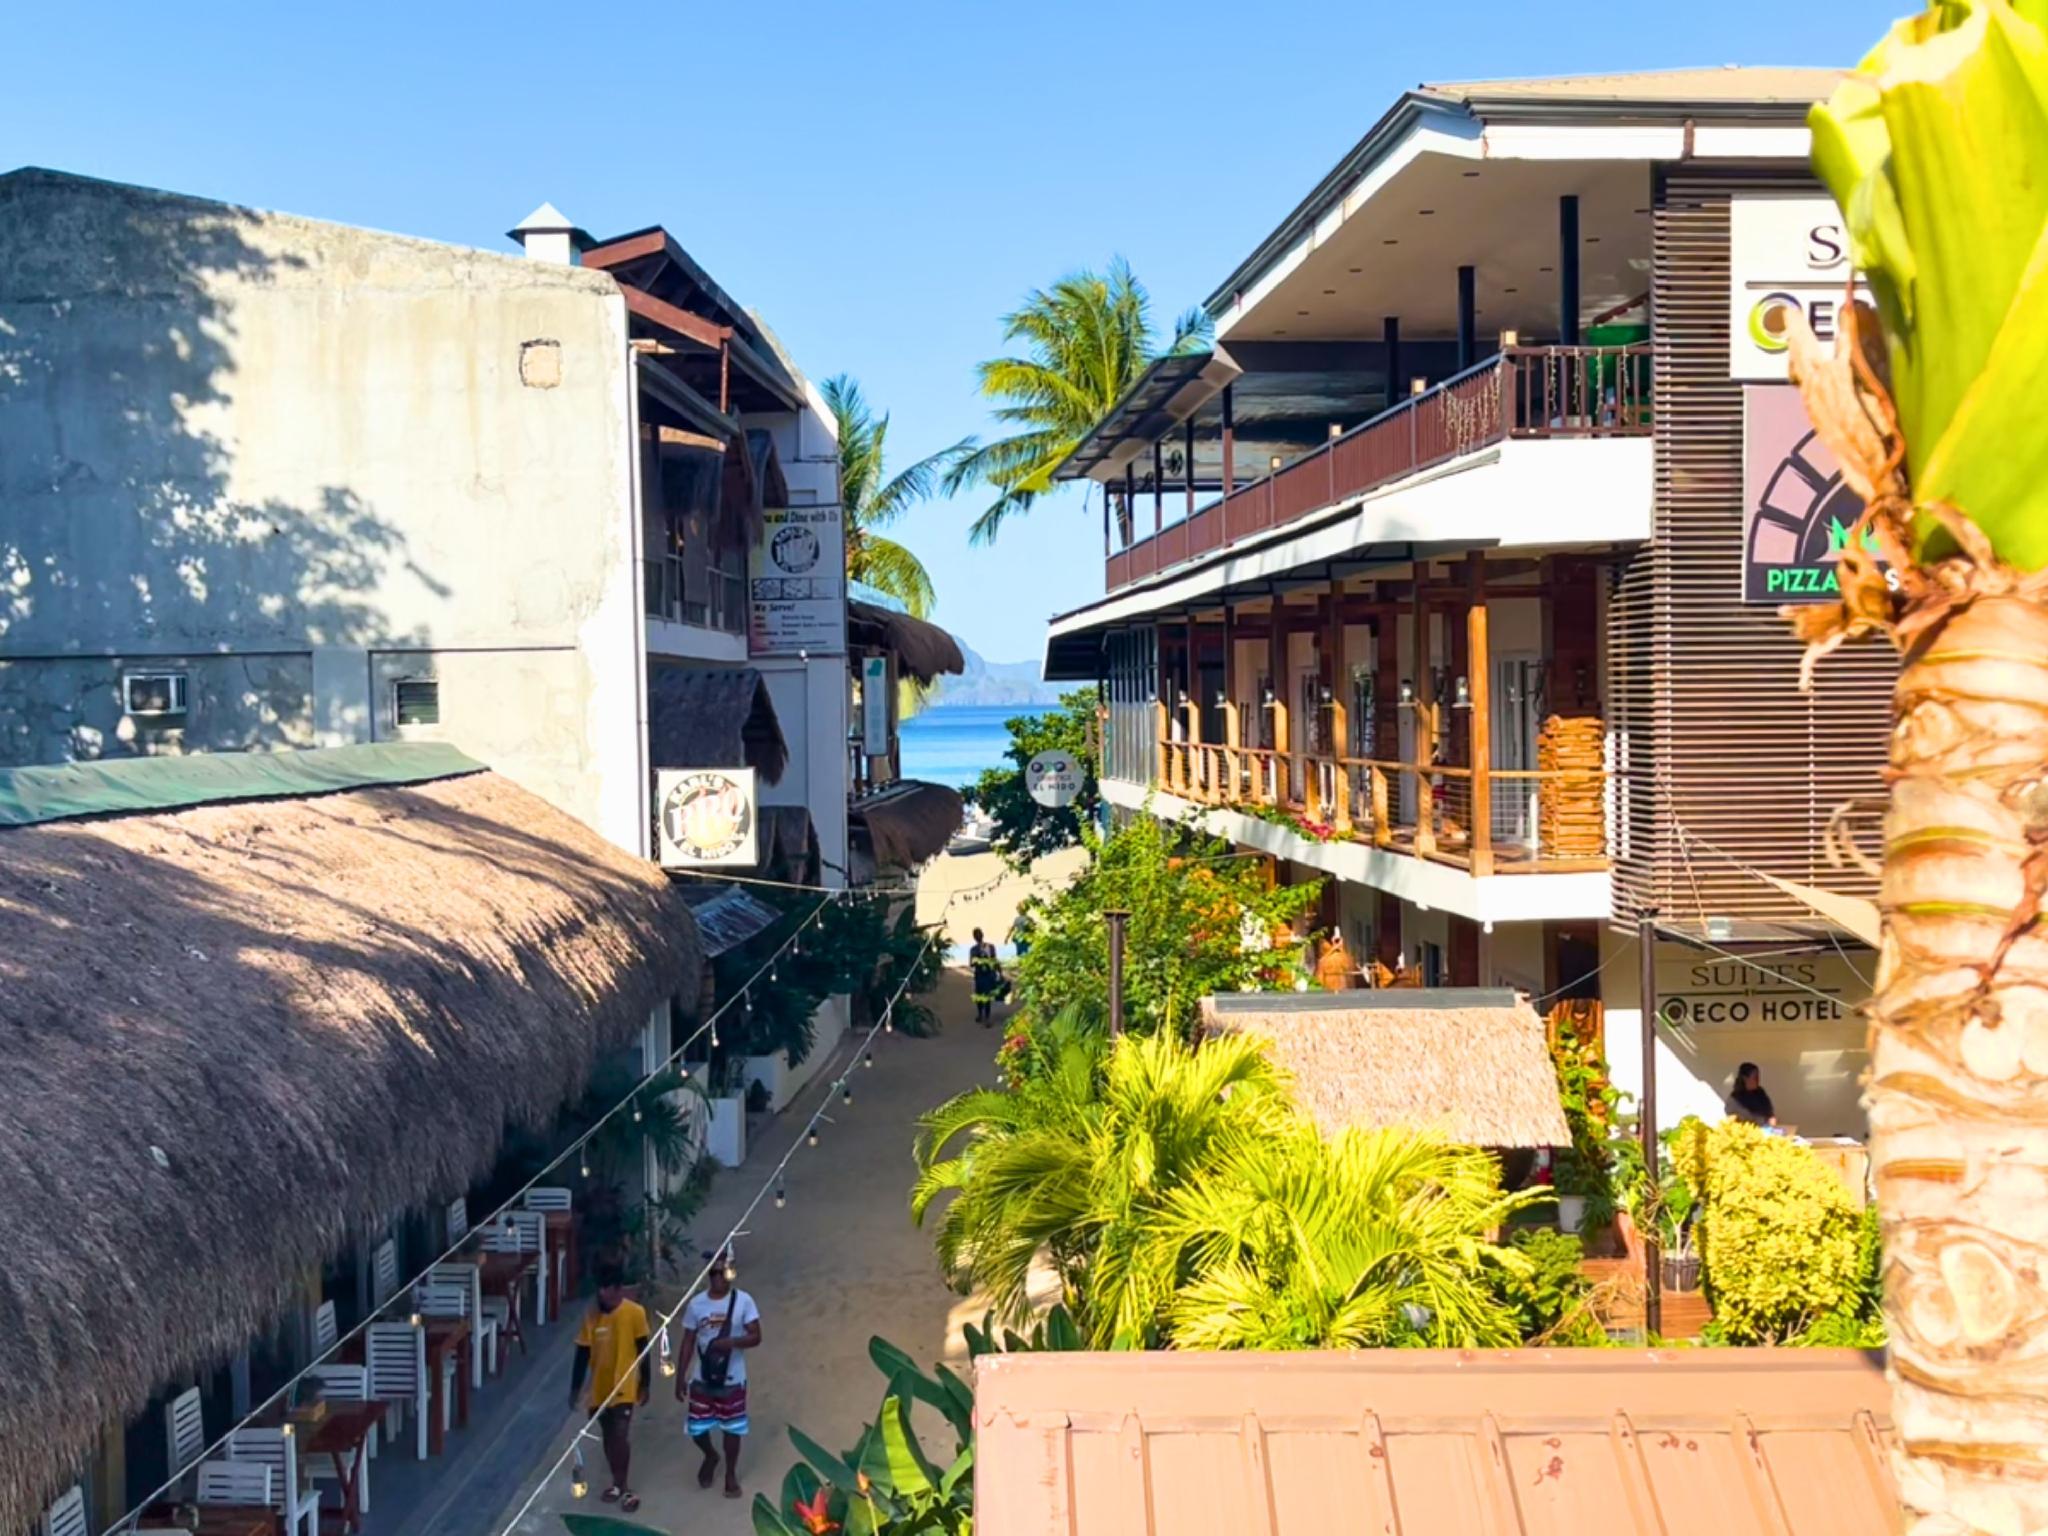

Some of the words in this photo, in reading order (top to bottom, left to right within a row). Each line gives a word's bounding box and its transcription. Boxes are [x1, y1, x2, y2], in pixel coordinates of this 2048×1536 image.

[790, 511, 808, 523] Dine
[811, 511, 826, 522] with
[1767, 569, 1840, 592] PIZZA
[1691, 963, 1816, 987] SUITES
[1693, 1001, 1749, 1023] ECO
[1762, 1000, 1841, 1021] HOTEL
